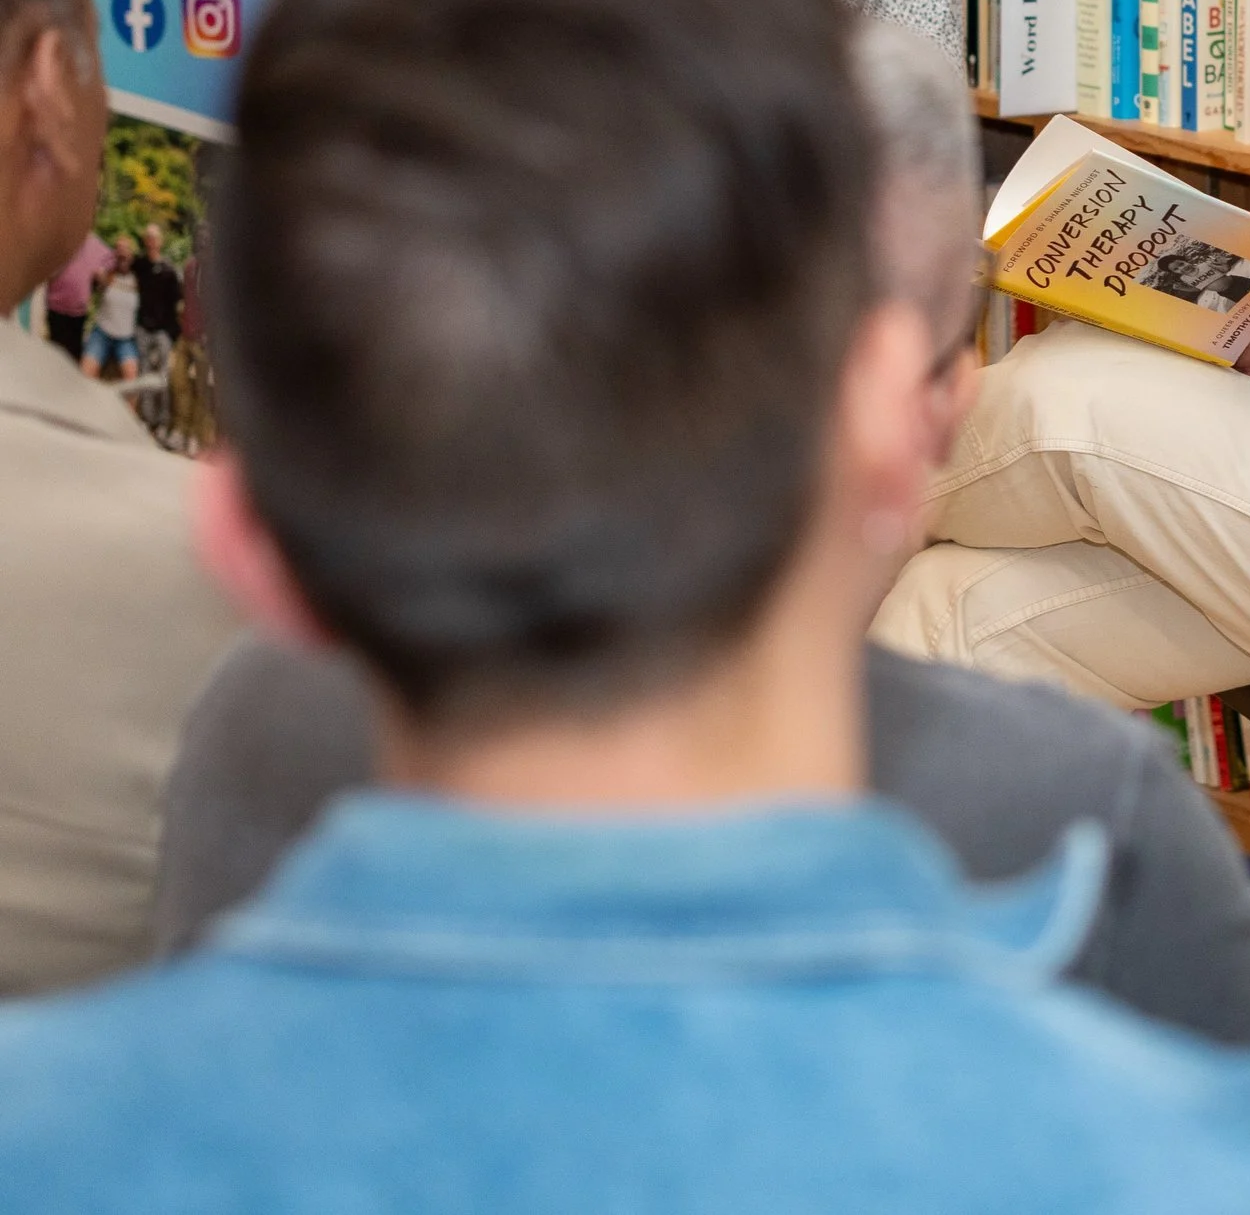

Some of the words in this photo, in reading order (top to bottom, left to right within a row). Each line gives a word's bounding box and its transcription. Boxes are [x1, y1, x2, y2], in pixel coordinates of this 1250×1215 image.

[1022, 15, 1038, 76] Word
[1003, 231, 1038, 273] FOREWORD
[1037, 222, 1047, 233] BY
[1046, 196, 1073, 224] SHAUNA
[1071, 168, 1101, 199] NIEQUIST
[1025, 168, 1127, 289] CONVERSION
[1065, 195, 1154, 281] THERAPY
[1103, 204, 1187, 297] DROPOUT
[1215, 319, 1234, 341] QUEER
